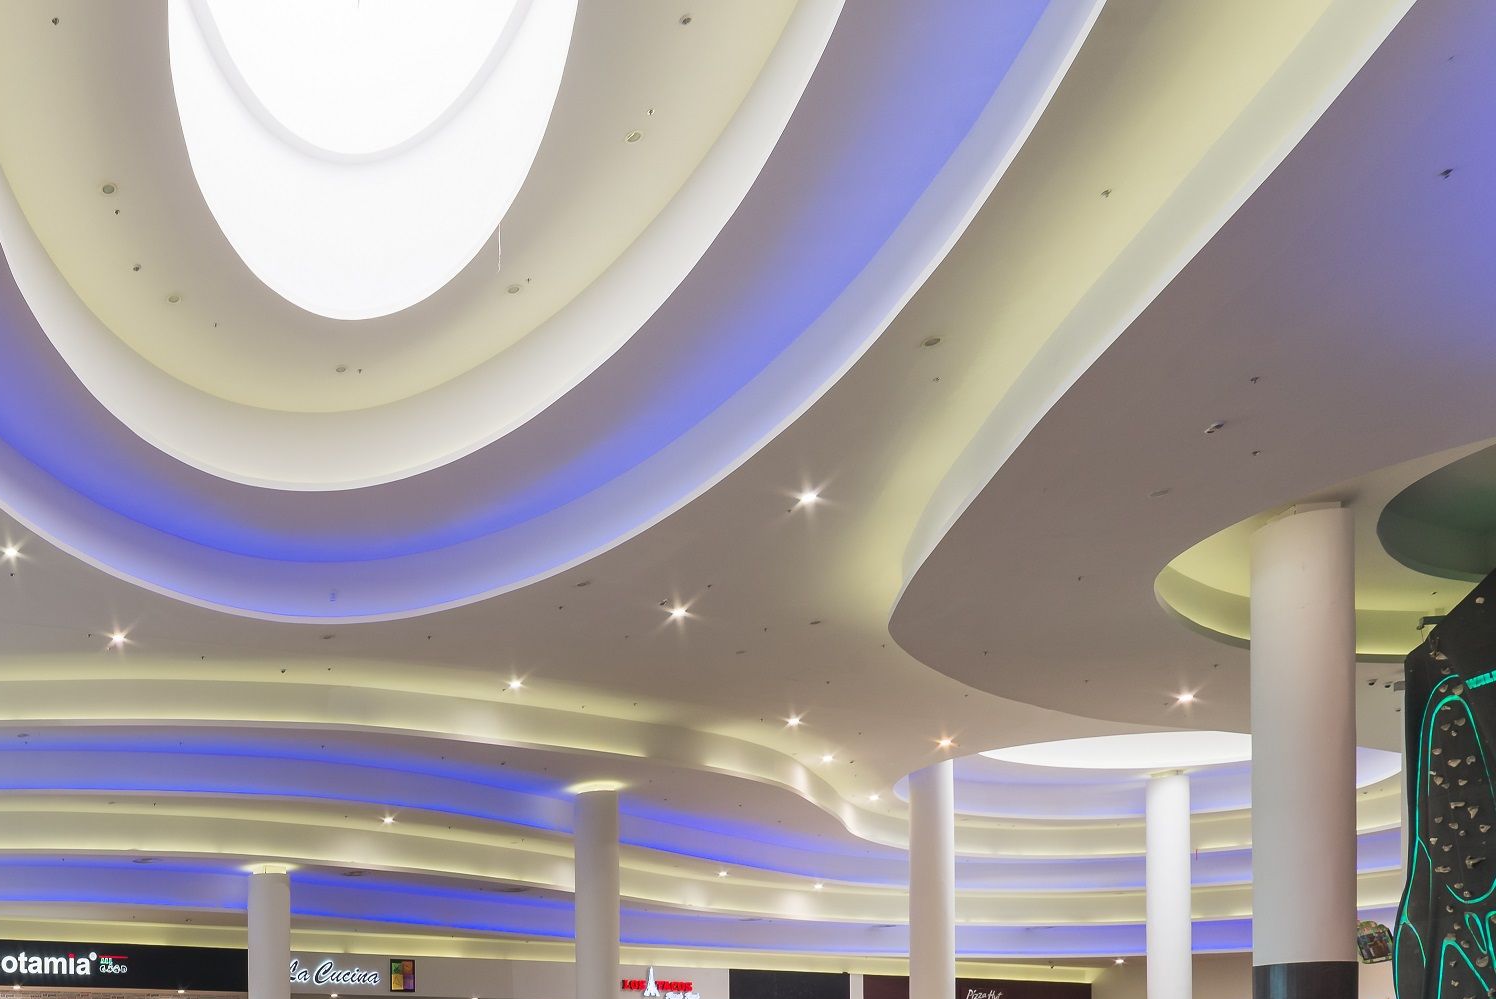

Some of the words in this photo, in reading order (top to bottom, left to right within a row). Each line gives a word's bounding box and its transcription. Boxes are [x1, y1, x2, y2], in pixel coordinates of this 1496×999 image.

[313, 959, 380, 985] Cucina
[622, 979, 646, 990] LOS
[655, 980, 692, 992] TACOS
[966, 989, 987, 999] Pizza
[987, 990, 1002, 999] Hut
